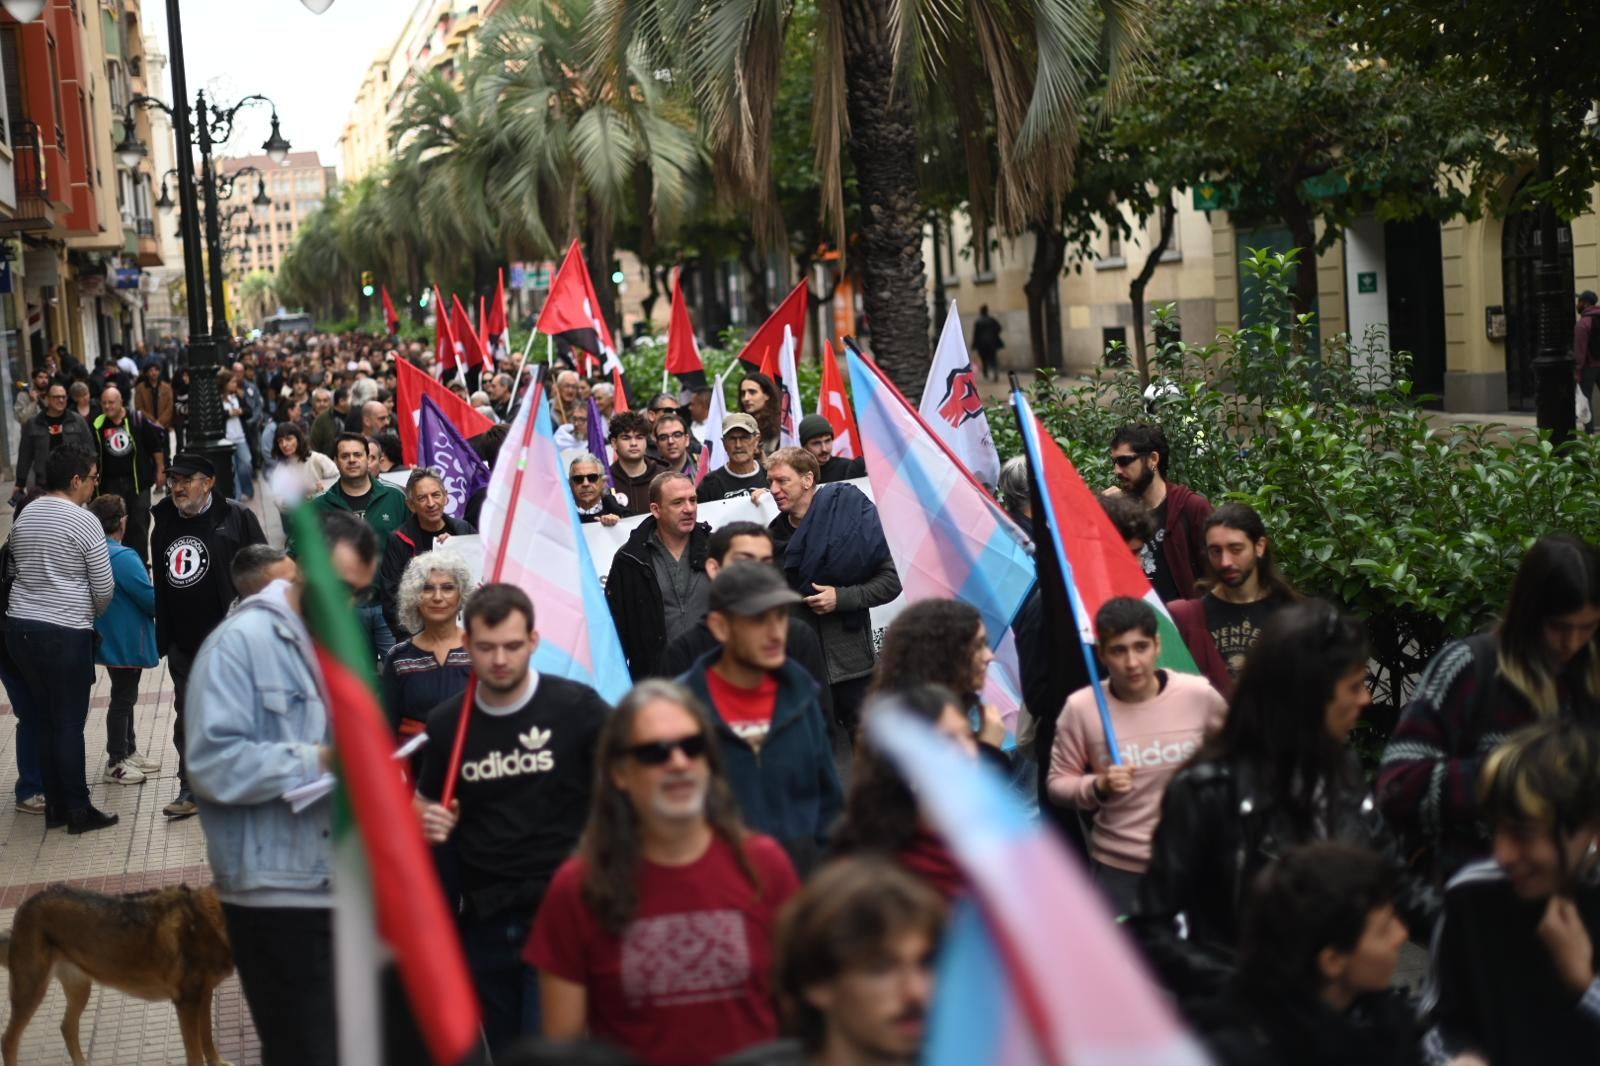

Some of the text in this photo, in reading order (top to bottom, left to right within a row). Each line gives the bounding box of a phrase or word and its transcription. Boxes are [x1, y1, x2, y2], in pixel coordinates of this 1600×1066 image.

[166, 538, 204, 557] ABSOLUCIÓN
[174, 548, 192, 576] 6
[1210, 625, 1262, 640] VENGE
[462, 748, 555, 781] adidas
[1102, 738, 1196, 768] didas
